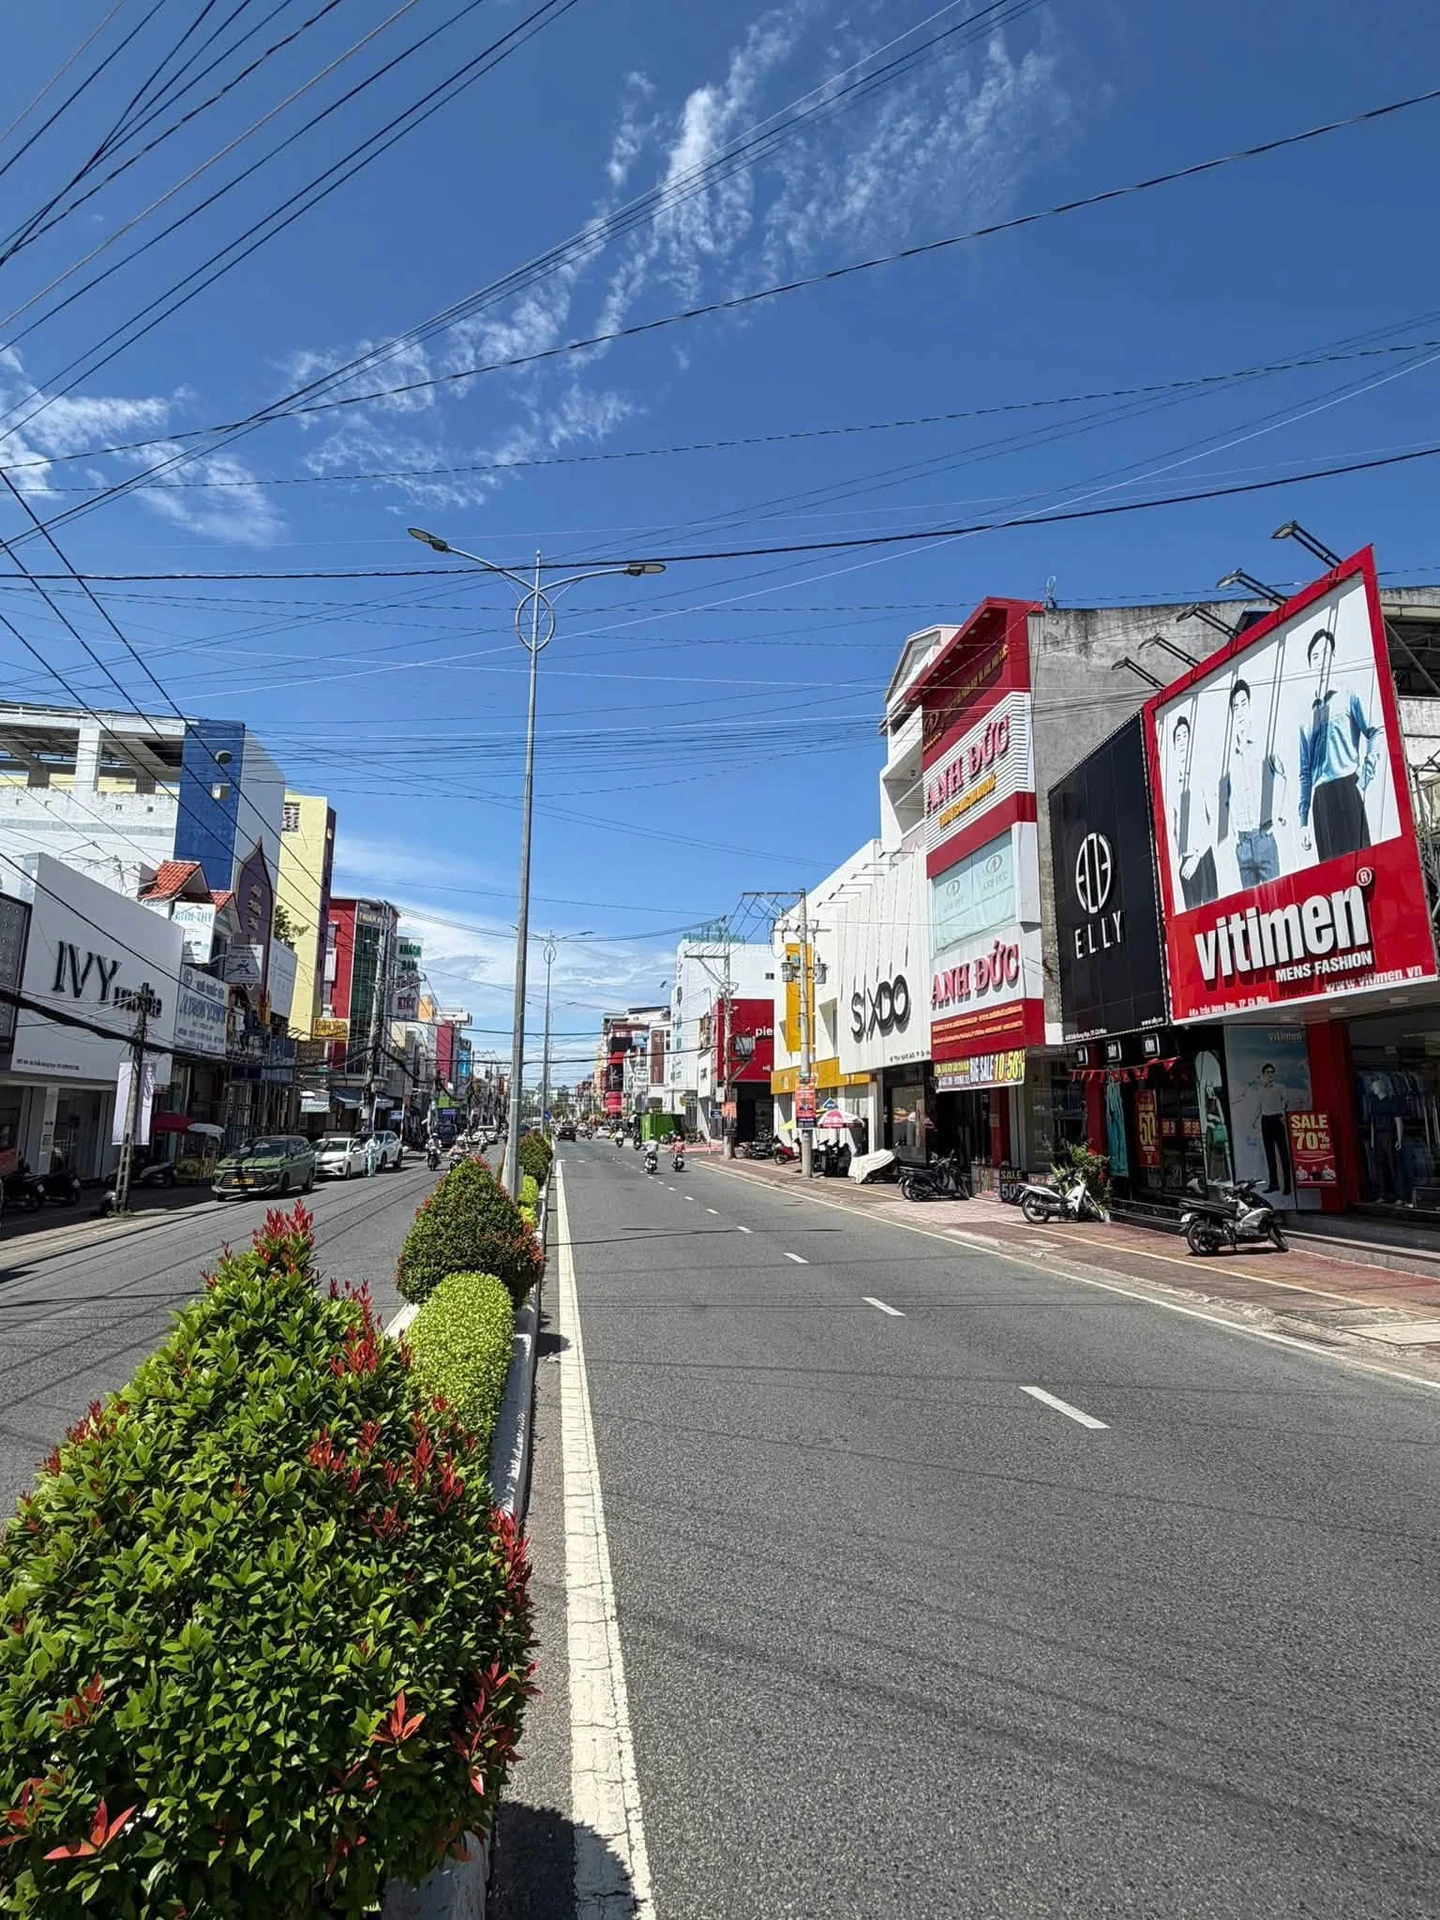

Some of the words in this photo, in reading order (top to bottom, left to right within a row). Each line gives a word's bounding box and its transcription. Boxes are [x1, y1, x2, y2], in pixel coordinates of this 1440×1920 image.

[926, 757, 965, 814] ANH
[967, 716, 1010, 777] ĐỨC
[1074, 909, 1124, 960] ELLY
[1195, 884, 1370, 982] vitimen
[52, 941, 122, 1003] IVY
[931, 962, 970, 1006] ANH
[974, 939, 1020, 991] ĐỨC
[1275, 963, 1312, 983] MENS
[1314, 950, 1373, 975] FASHION
[851, 975, 911, 1043] SIXDO
[1290, 1114, 1329, 1129] SALE
[1292, 1131, 1330, 1150] 70%
[1000, 1170, 1023, 1180] SALE
